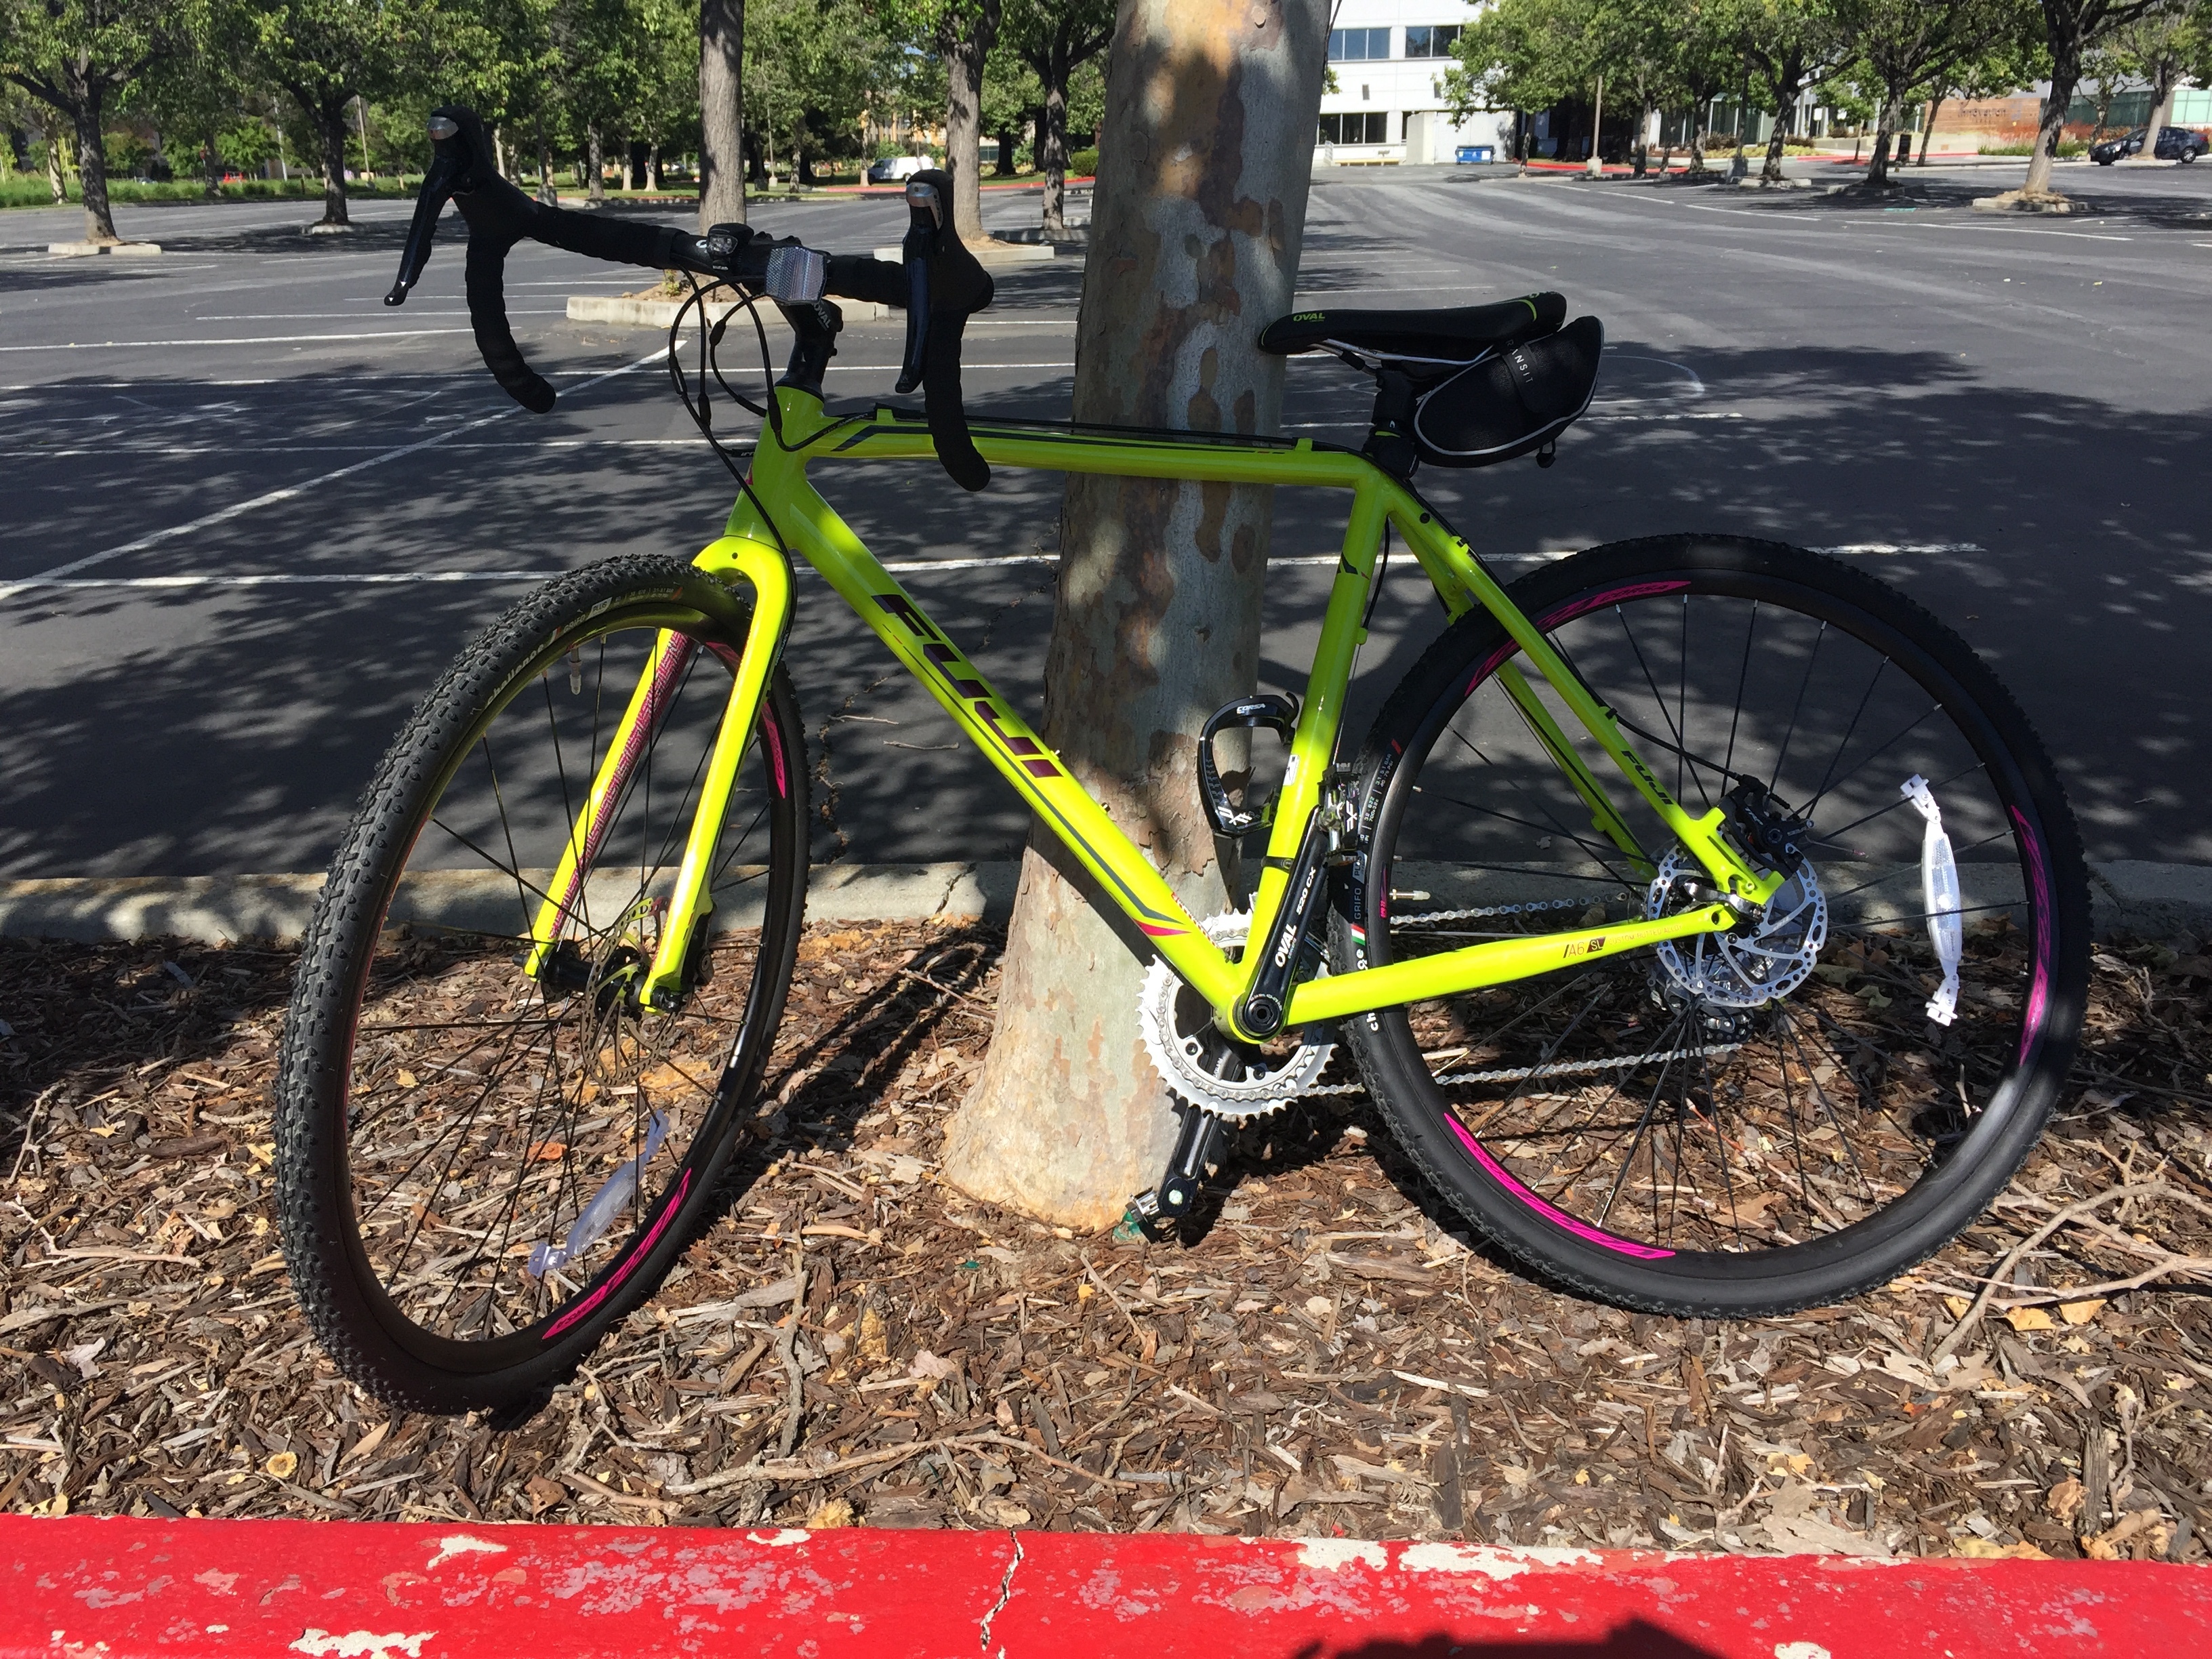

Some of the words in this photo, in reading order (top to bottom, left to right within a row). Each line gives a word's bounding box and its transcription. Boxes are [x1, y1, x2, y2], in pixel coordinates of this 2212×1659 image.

[1293, 312, 1326, 322] OVAL
[1504, 339, 1534, 382] RANSIT
[563, 614, 586, 634] GRIFO
[871, 594, 1064, 779] FUJI
[1620, 750, 1674, 805] FUJI
[1275, 924, 1297, 968] OVAL
[1296, 887, 1308, 915] 520
[1306, 866, 1316, 888] CX
[1589, 938, 1605, 951] SL
[1608, 935, 1635, 945] CUSTOM
